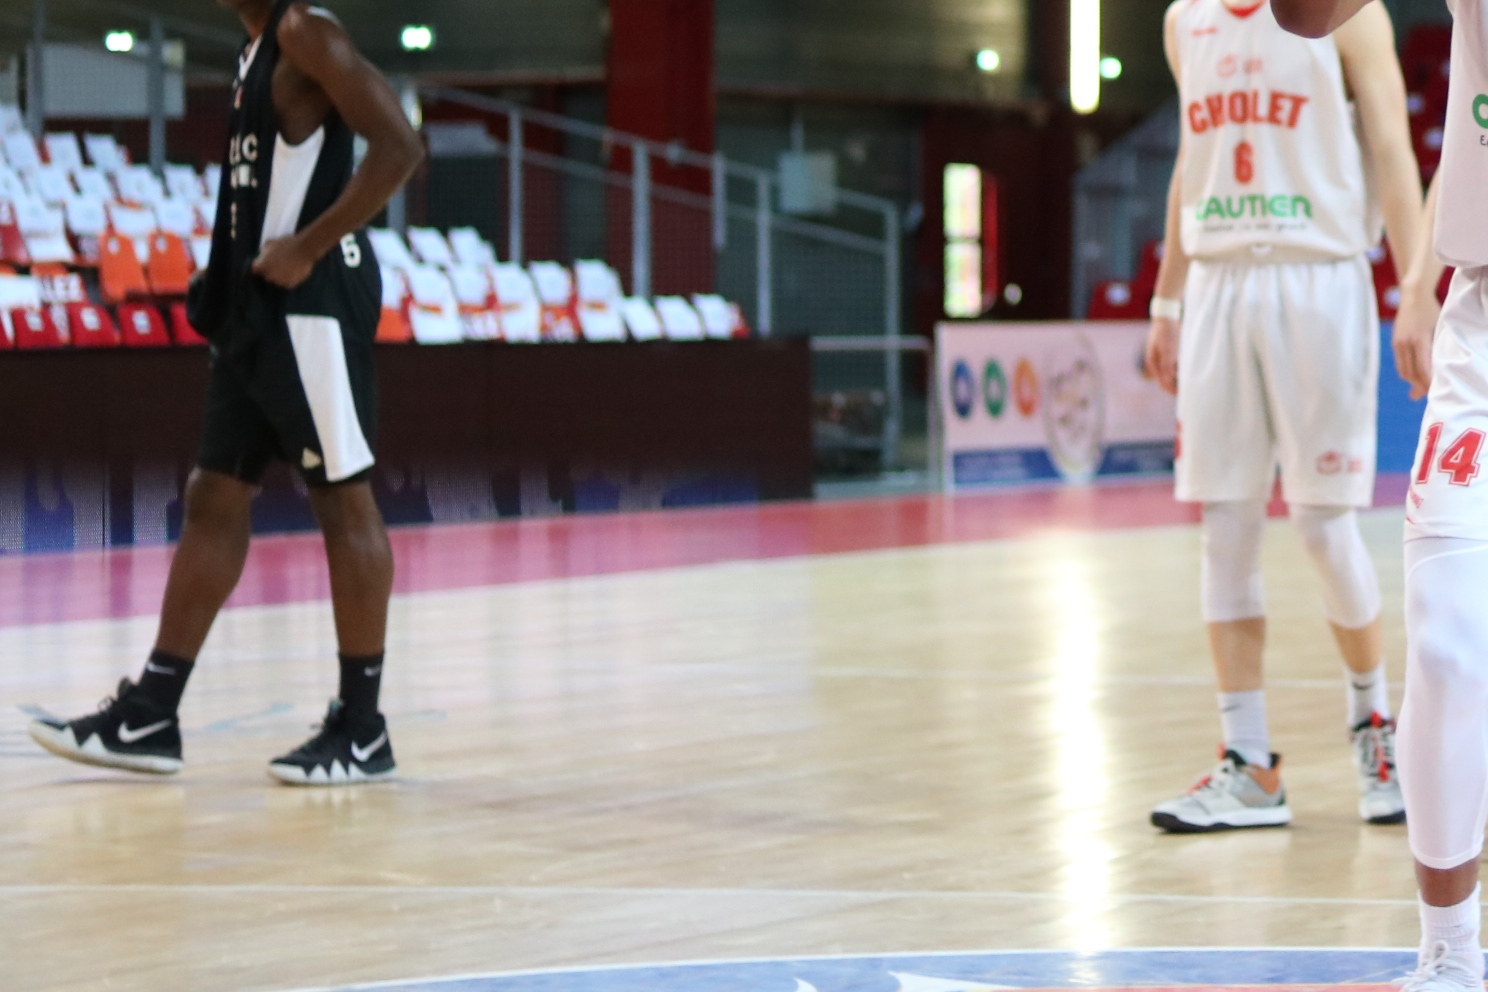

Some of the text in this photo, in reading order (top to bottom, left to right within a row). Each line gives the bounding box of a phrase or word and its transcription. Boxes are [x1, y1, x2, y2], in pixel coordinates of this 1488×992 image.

[1188, 90, 1310, 135] CHOLET
[1233, 140, 1255, 184] 6
[1415, 421, 1487, 487] 14
